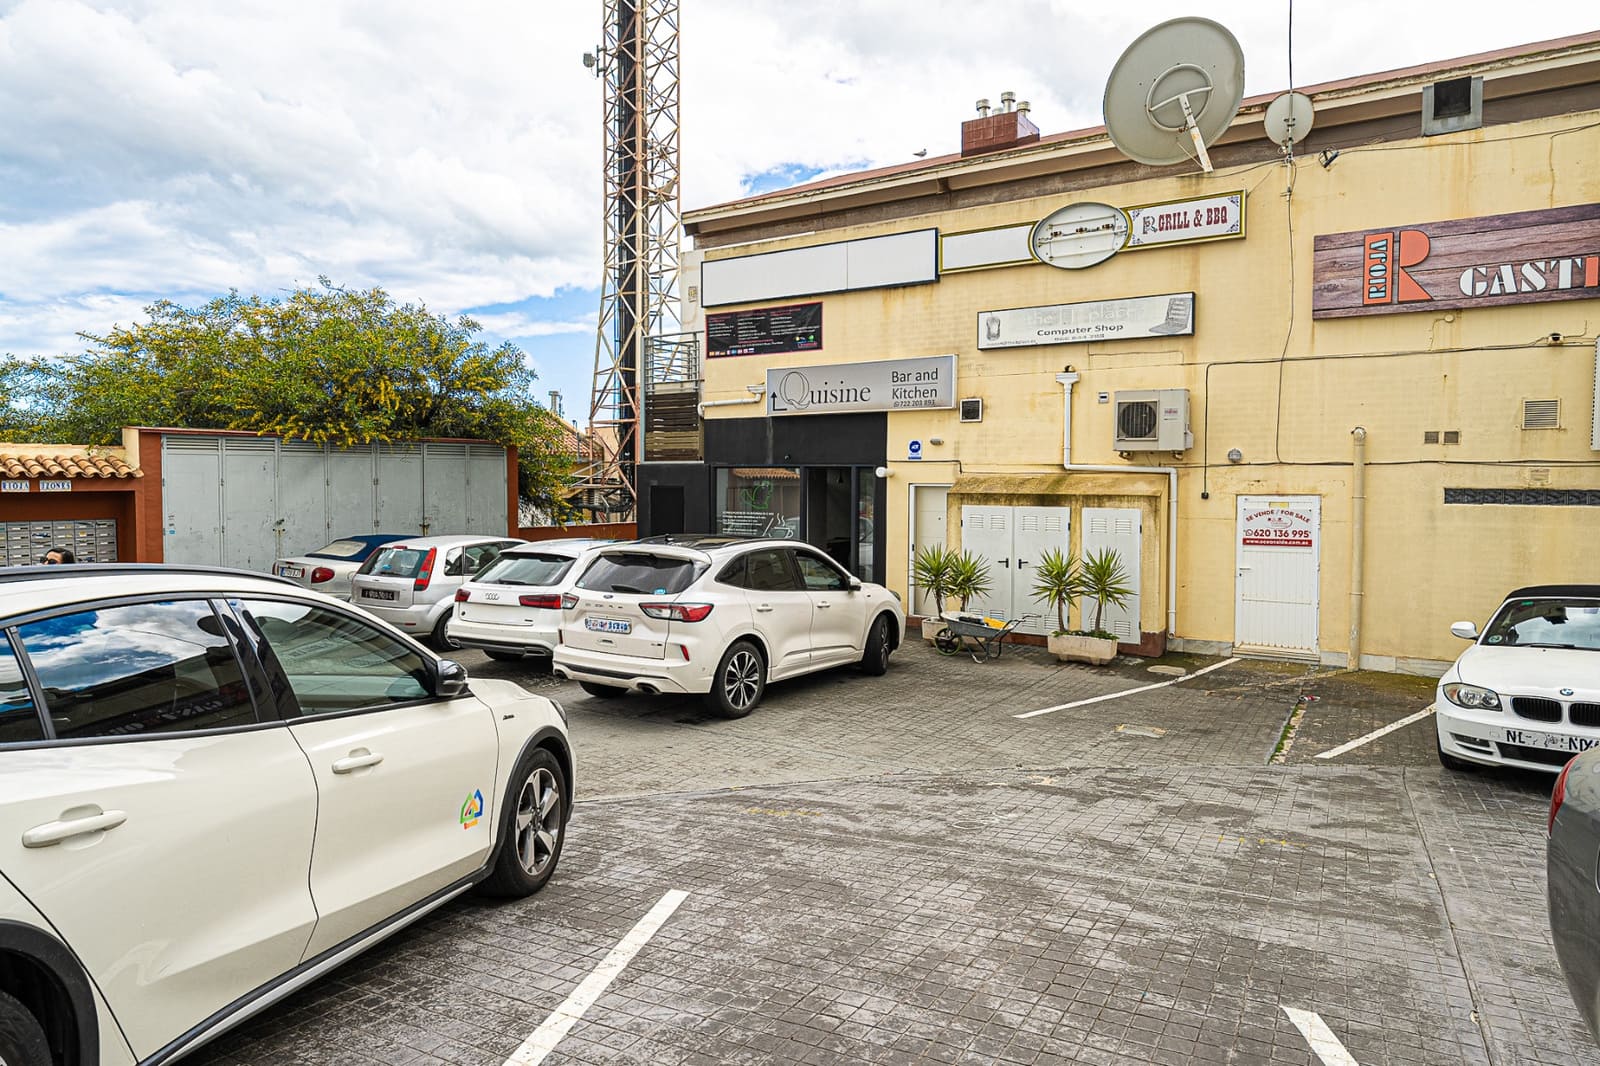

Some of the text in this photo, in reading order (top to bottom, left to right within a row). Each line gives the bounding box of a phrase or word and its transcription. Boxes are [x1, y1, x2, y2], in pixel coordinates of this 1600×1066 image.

[1158, 211, 1190, 231] GRILL
[1193, 209, 1203, 227] &
[1206, 206, 1227, 225] BBQ
[1368, 238, 1388, 299] RIOJA
[1037, 326, 1092, 337] Computer
[1094, 324, 1124, 333] Shop
[892, 367, 938, 383] Bar and
[779, 371, 871, 410] Quisine
[892, 386, 938, 399] Kitchen
[1295, 513, 1310, 523] SALE
[1274, 529, 1290, 538] 136
[1291, 529, 1310, 538] 995
